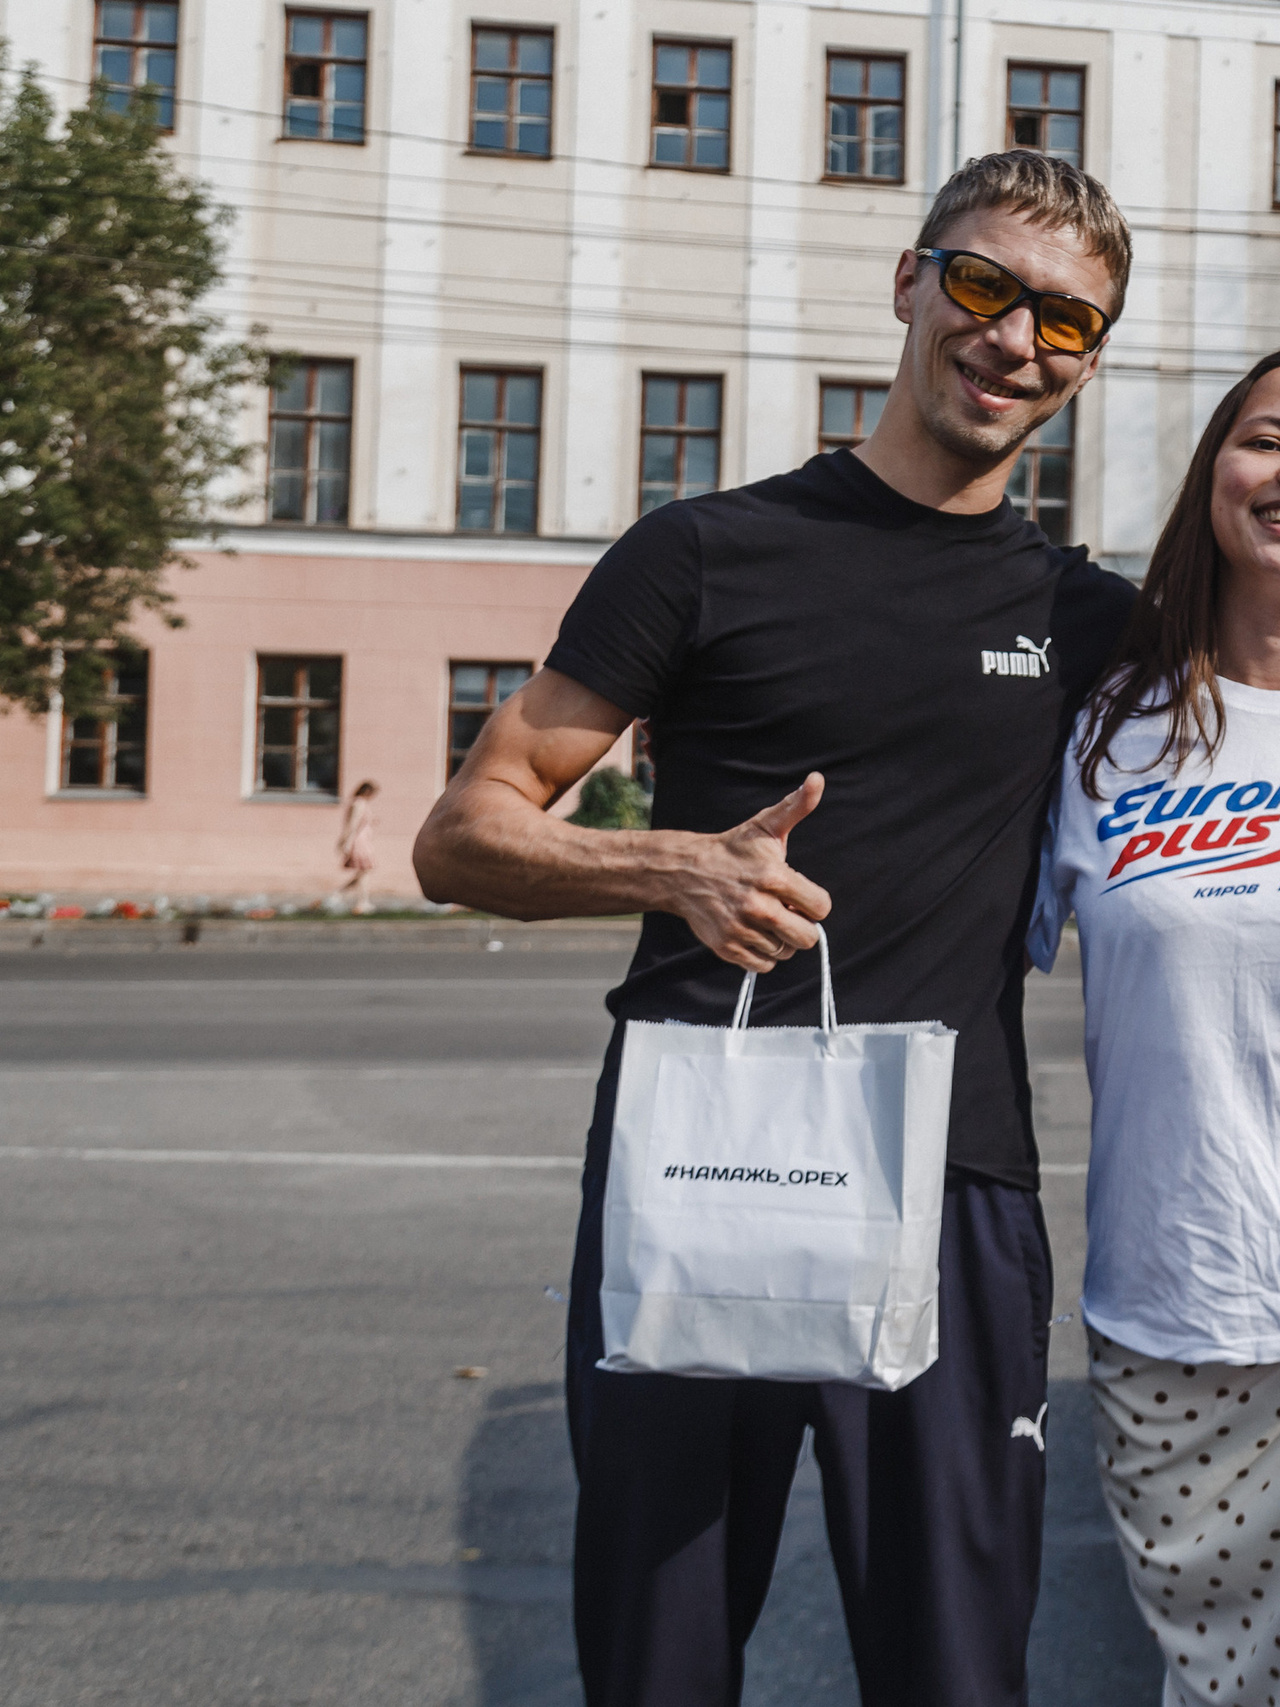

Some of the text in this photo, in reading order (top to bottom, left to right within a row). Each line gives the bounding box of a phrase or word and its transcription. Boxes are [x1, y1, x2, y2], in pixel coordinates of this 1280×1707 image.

[981, 649, 1041, 678] PUMA
[1193, 884, 1260, 898] КИРОВ
[664, 1164, 849, 1187] #НАМАЖЬ_ОРЕХ
